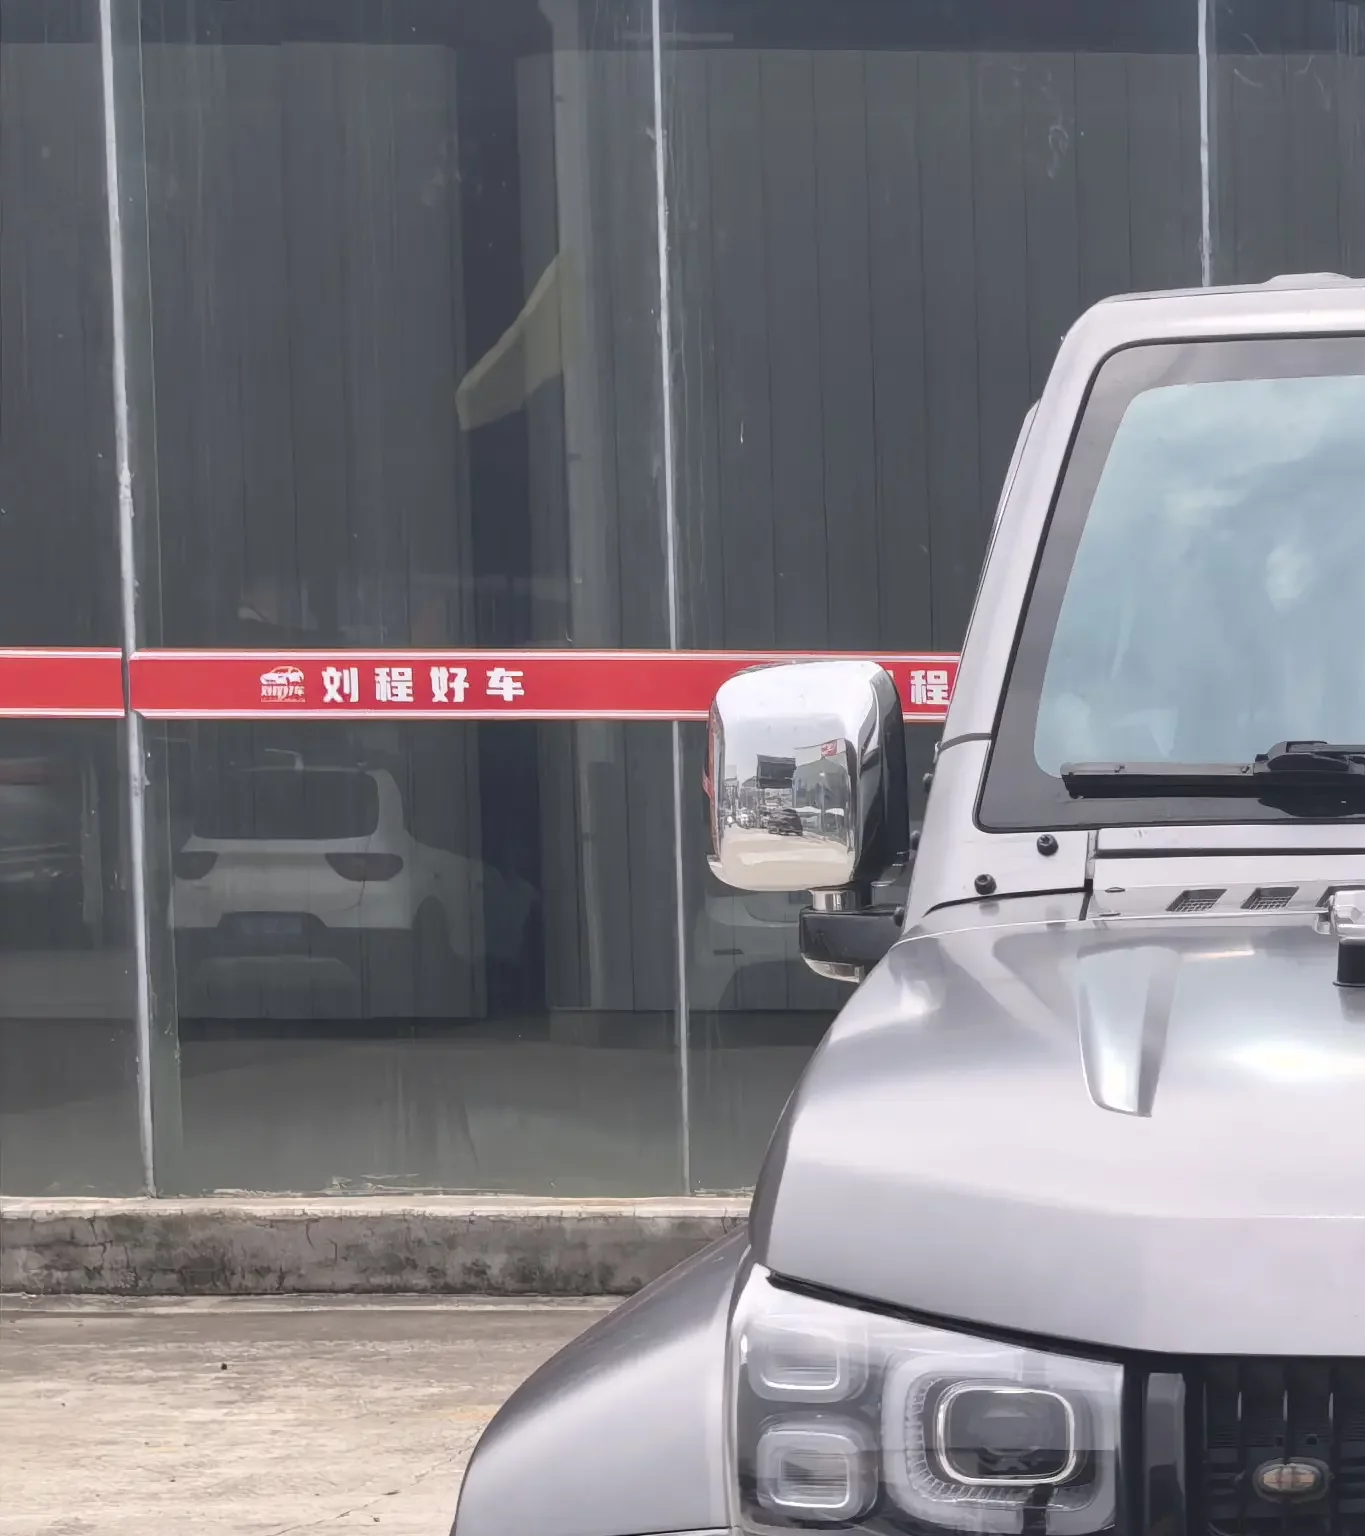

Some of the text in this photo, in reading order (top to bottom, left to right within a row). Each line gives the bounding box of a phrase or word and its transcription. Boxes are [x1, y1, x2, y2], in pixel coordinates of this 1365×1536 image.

[321, 666, 525, 703] 刘程好车
[886, 669, 949, 704] 程
